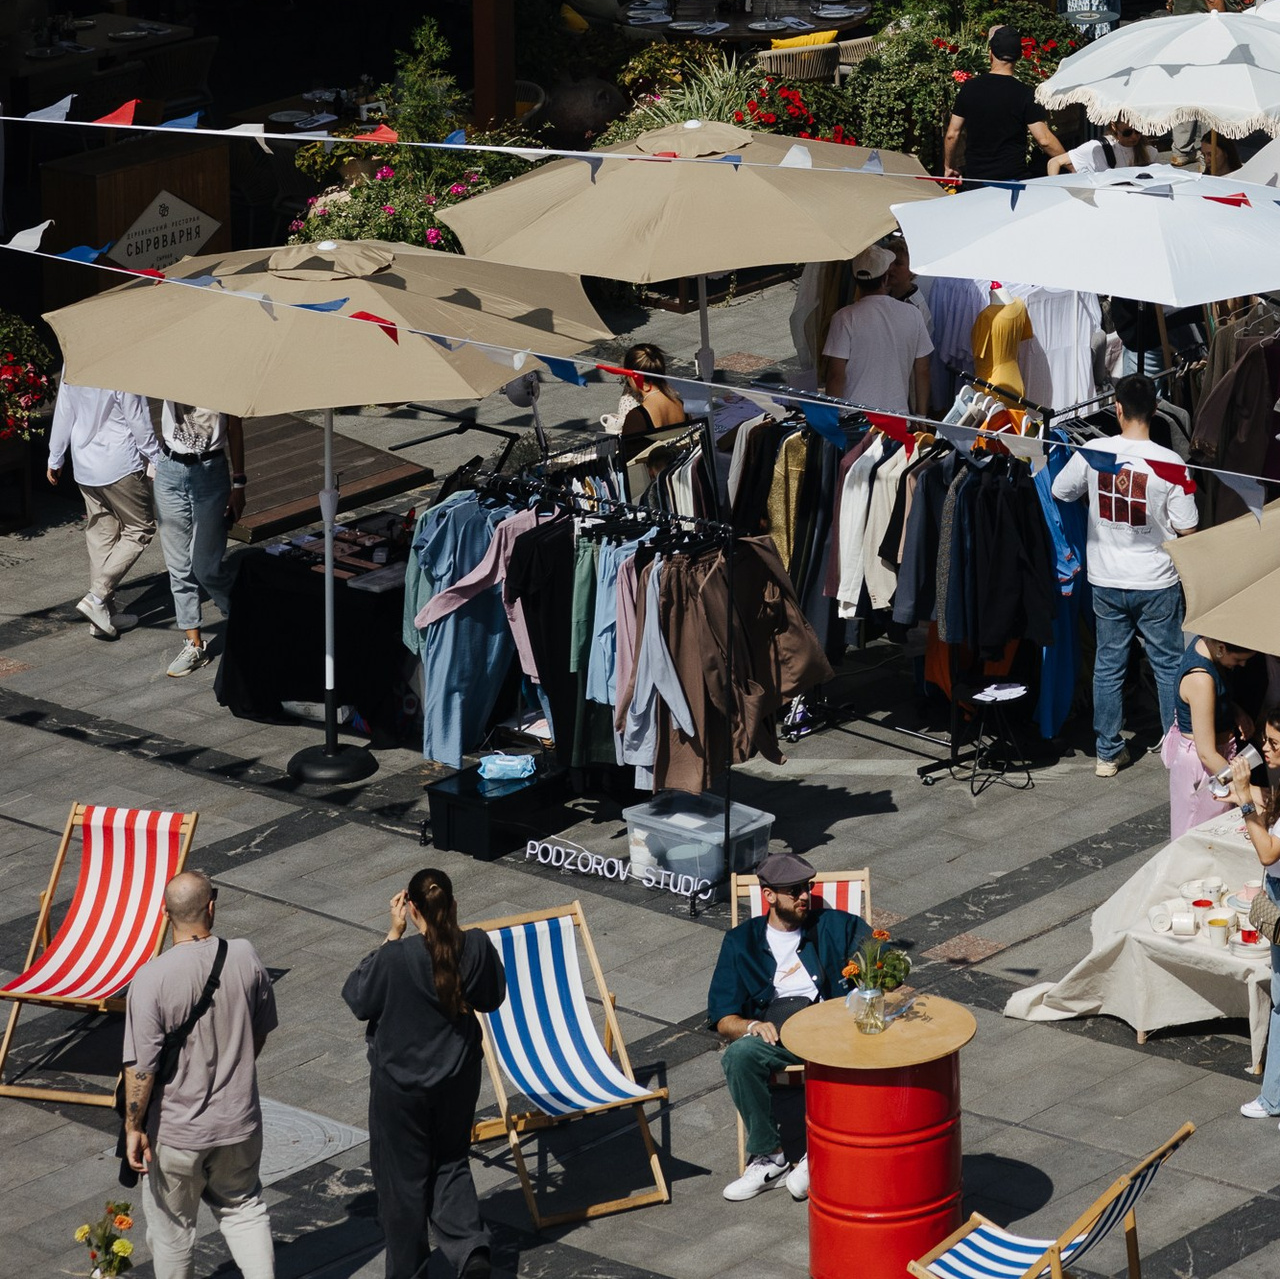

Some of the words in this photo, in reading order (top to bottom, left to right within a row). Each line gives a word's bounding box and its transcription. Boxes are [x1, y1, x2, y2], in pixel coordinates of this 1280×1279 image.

[126, 225, 201, 257] СЫРОВАРНЯ
[127, 223, 168, 240] ДЕРЕВЕНСКИЙ
[171, 216, 200, 227] РЕСТОРАН
[526, 840, 631, 881] PODZOROV
[642, 866, 712, 900] STUDIO
